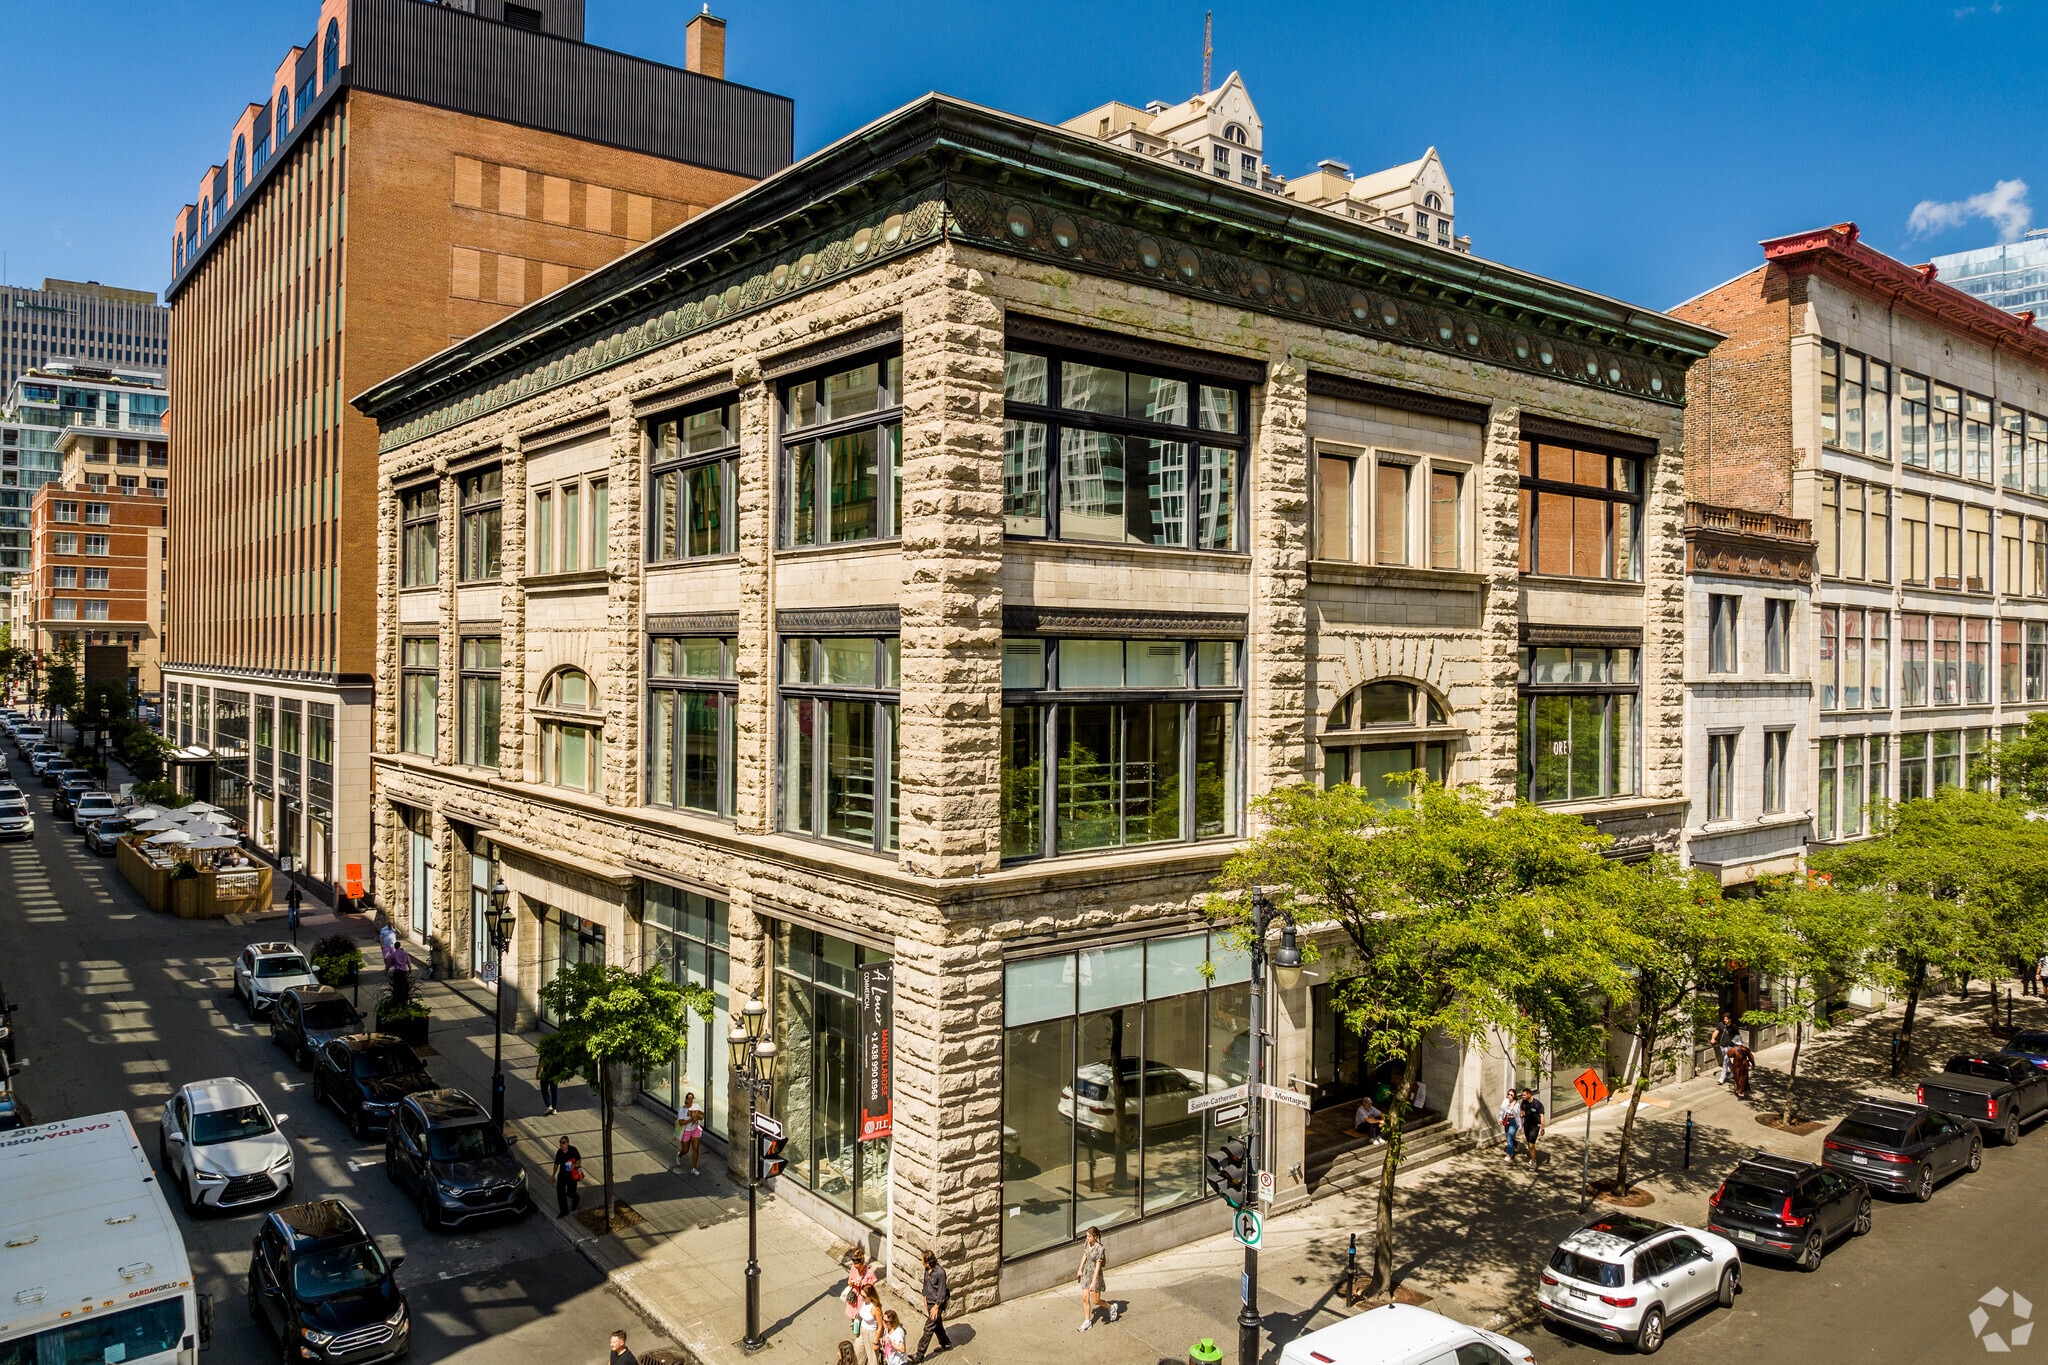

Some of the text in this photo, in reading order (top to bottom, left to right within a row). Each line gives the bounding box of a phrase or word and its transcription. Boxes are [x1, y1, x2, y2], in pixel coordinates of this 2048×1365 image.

[871, 986, 888, 1026] Louer
[871, 1031, 878, 1042] +1
[1190, 1092, 1238, 1111] Sainte-Catherine
[1274, 1091, 1308, 1108] Montagne
[128, 1281, 178, 1299] GARDAWORLD
